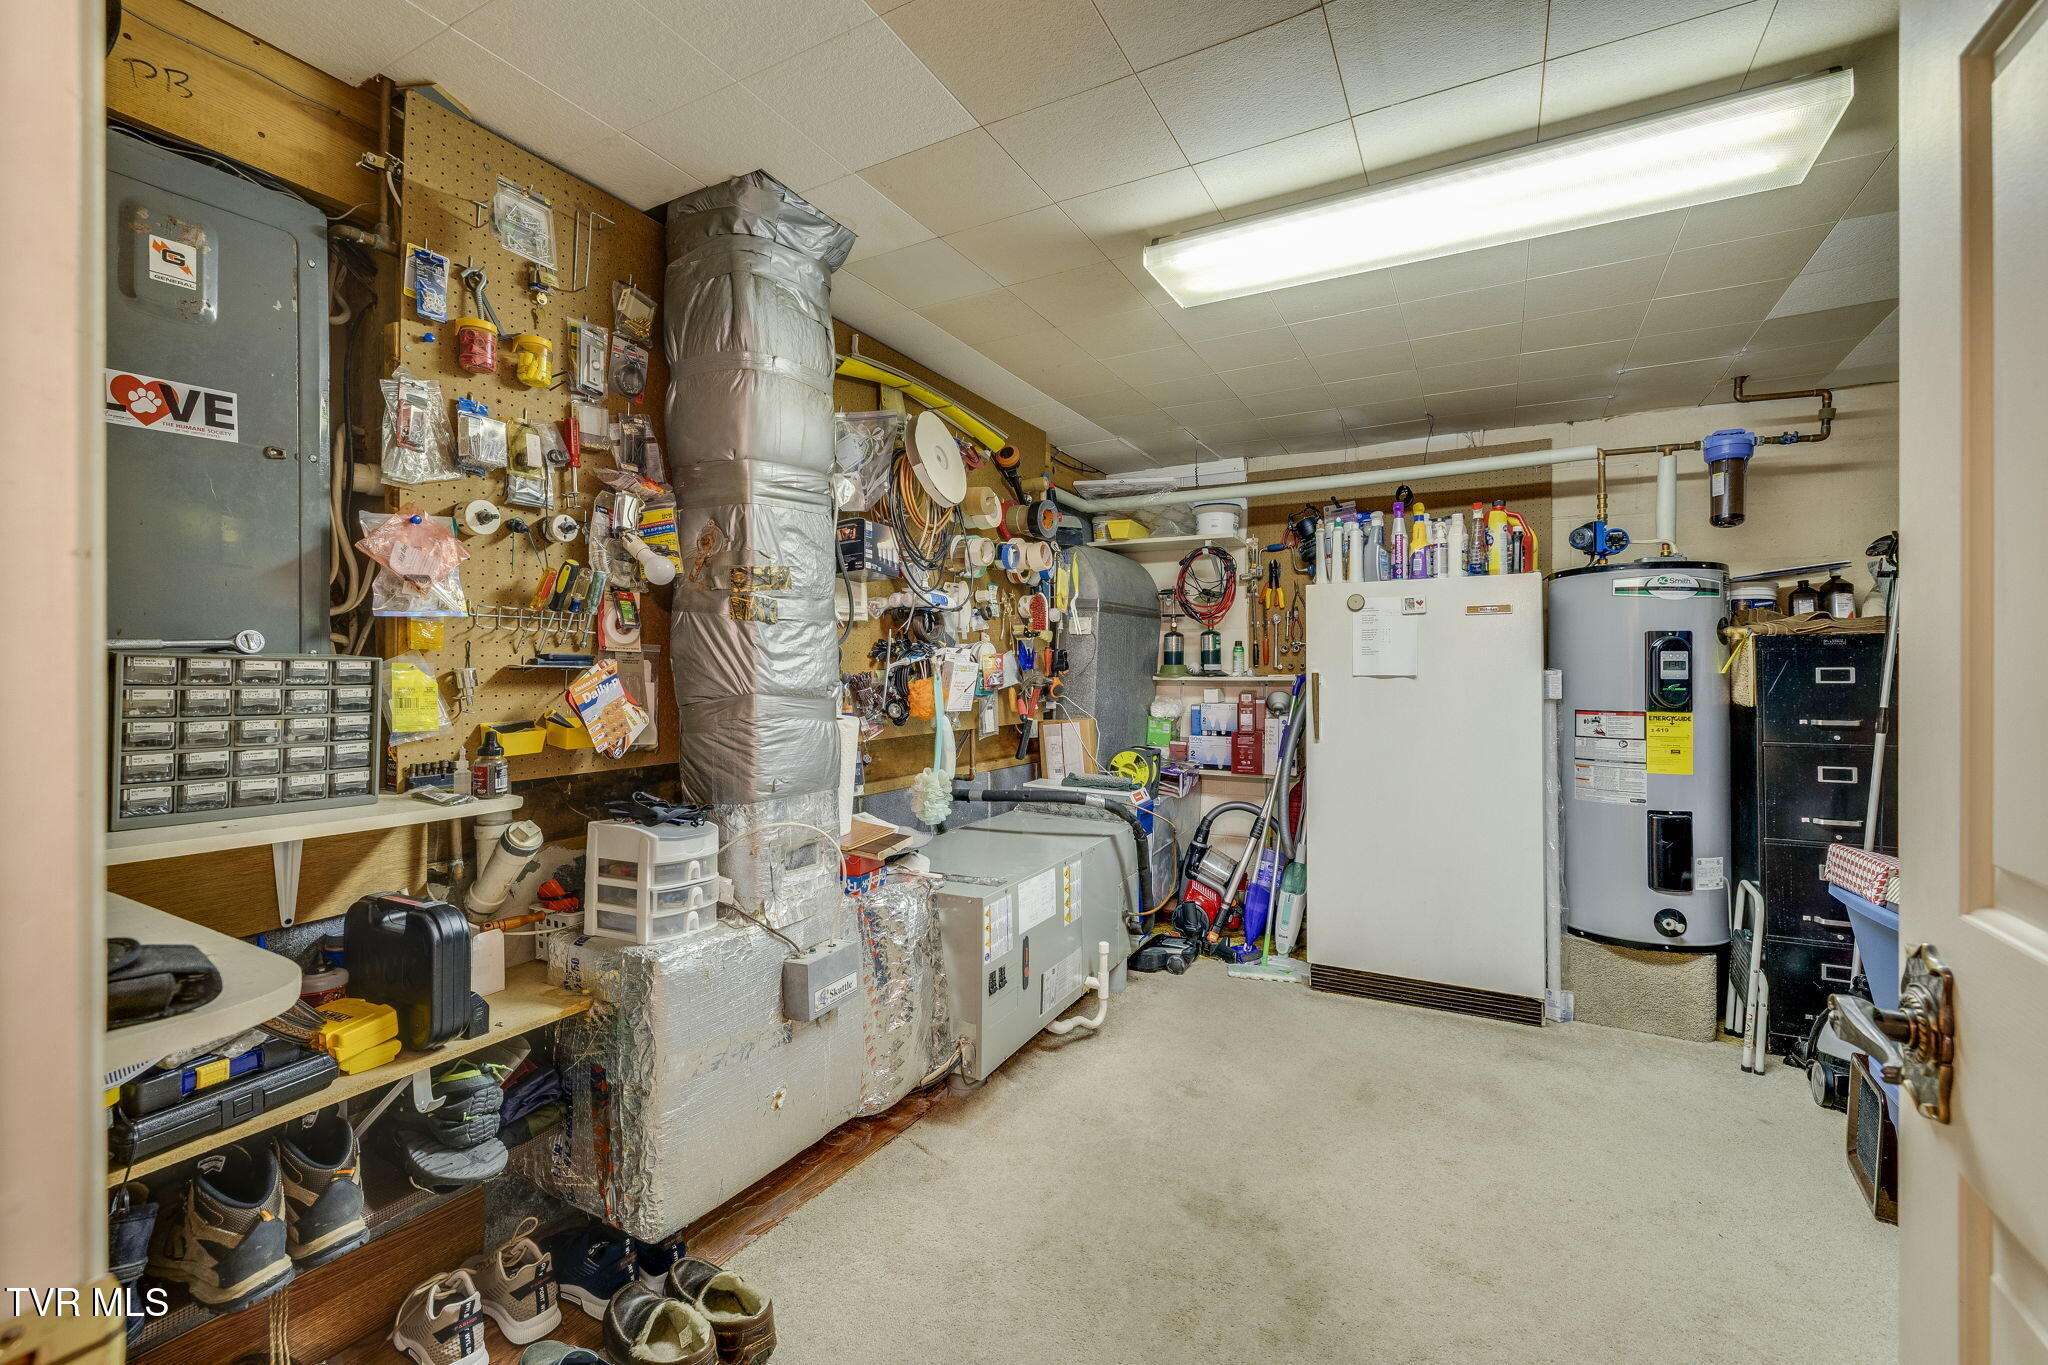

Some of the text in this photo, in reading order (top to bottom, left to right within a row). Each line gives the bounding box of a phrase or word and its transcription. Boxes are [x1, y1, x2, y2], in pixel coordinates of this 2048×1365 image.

[154, 274, 194, 289] GENERAL
[175, 424, 206, 433] HUMANE
[207, 428, 232, 437] SOCIETY
[1669, 577, 1692, 585] Smith
[829, 981, 853, 998] Skuttle
